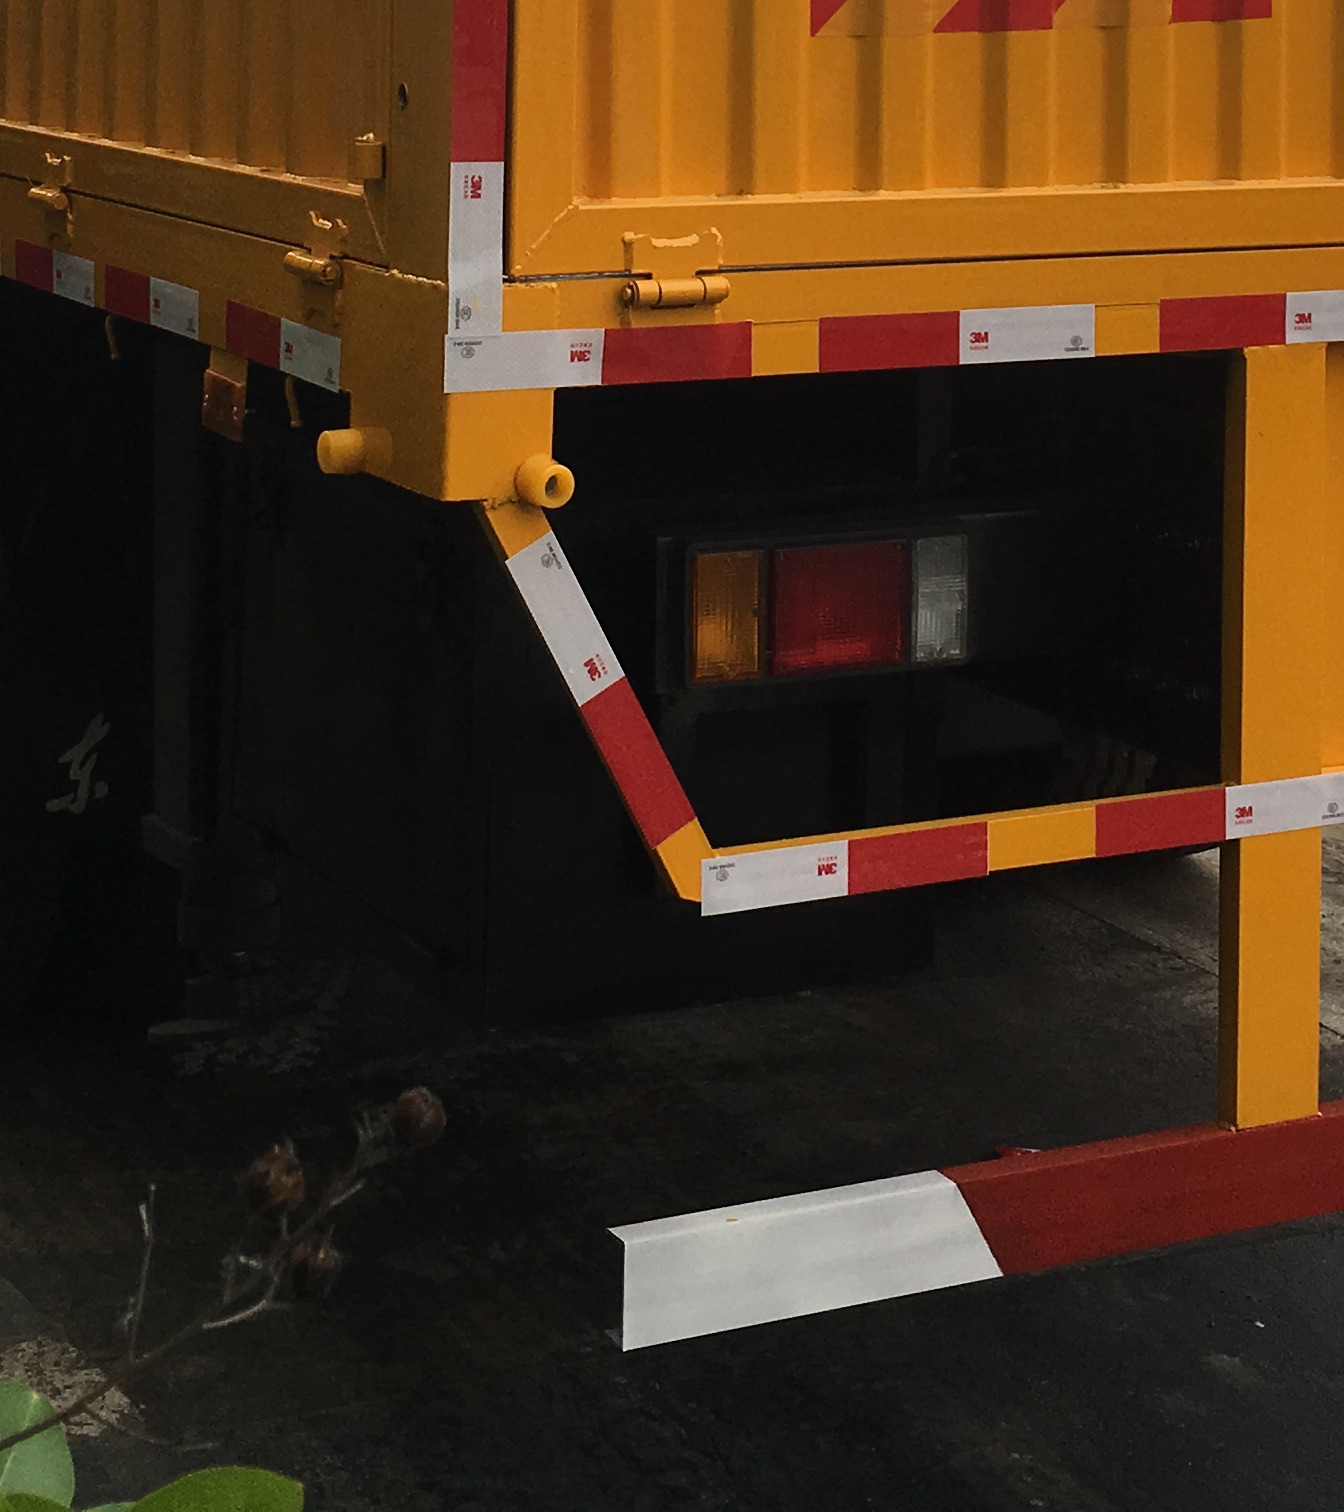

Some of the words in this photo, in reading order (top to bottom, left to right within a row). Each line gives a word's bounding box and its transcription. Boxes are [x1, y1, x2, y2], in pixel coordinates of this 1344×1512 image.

[1295, 312, 1313, 325] 3M
[969, 331, 989, 345] 3M
[1235, 806, 1253, 819] 3M
